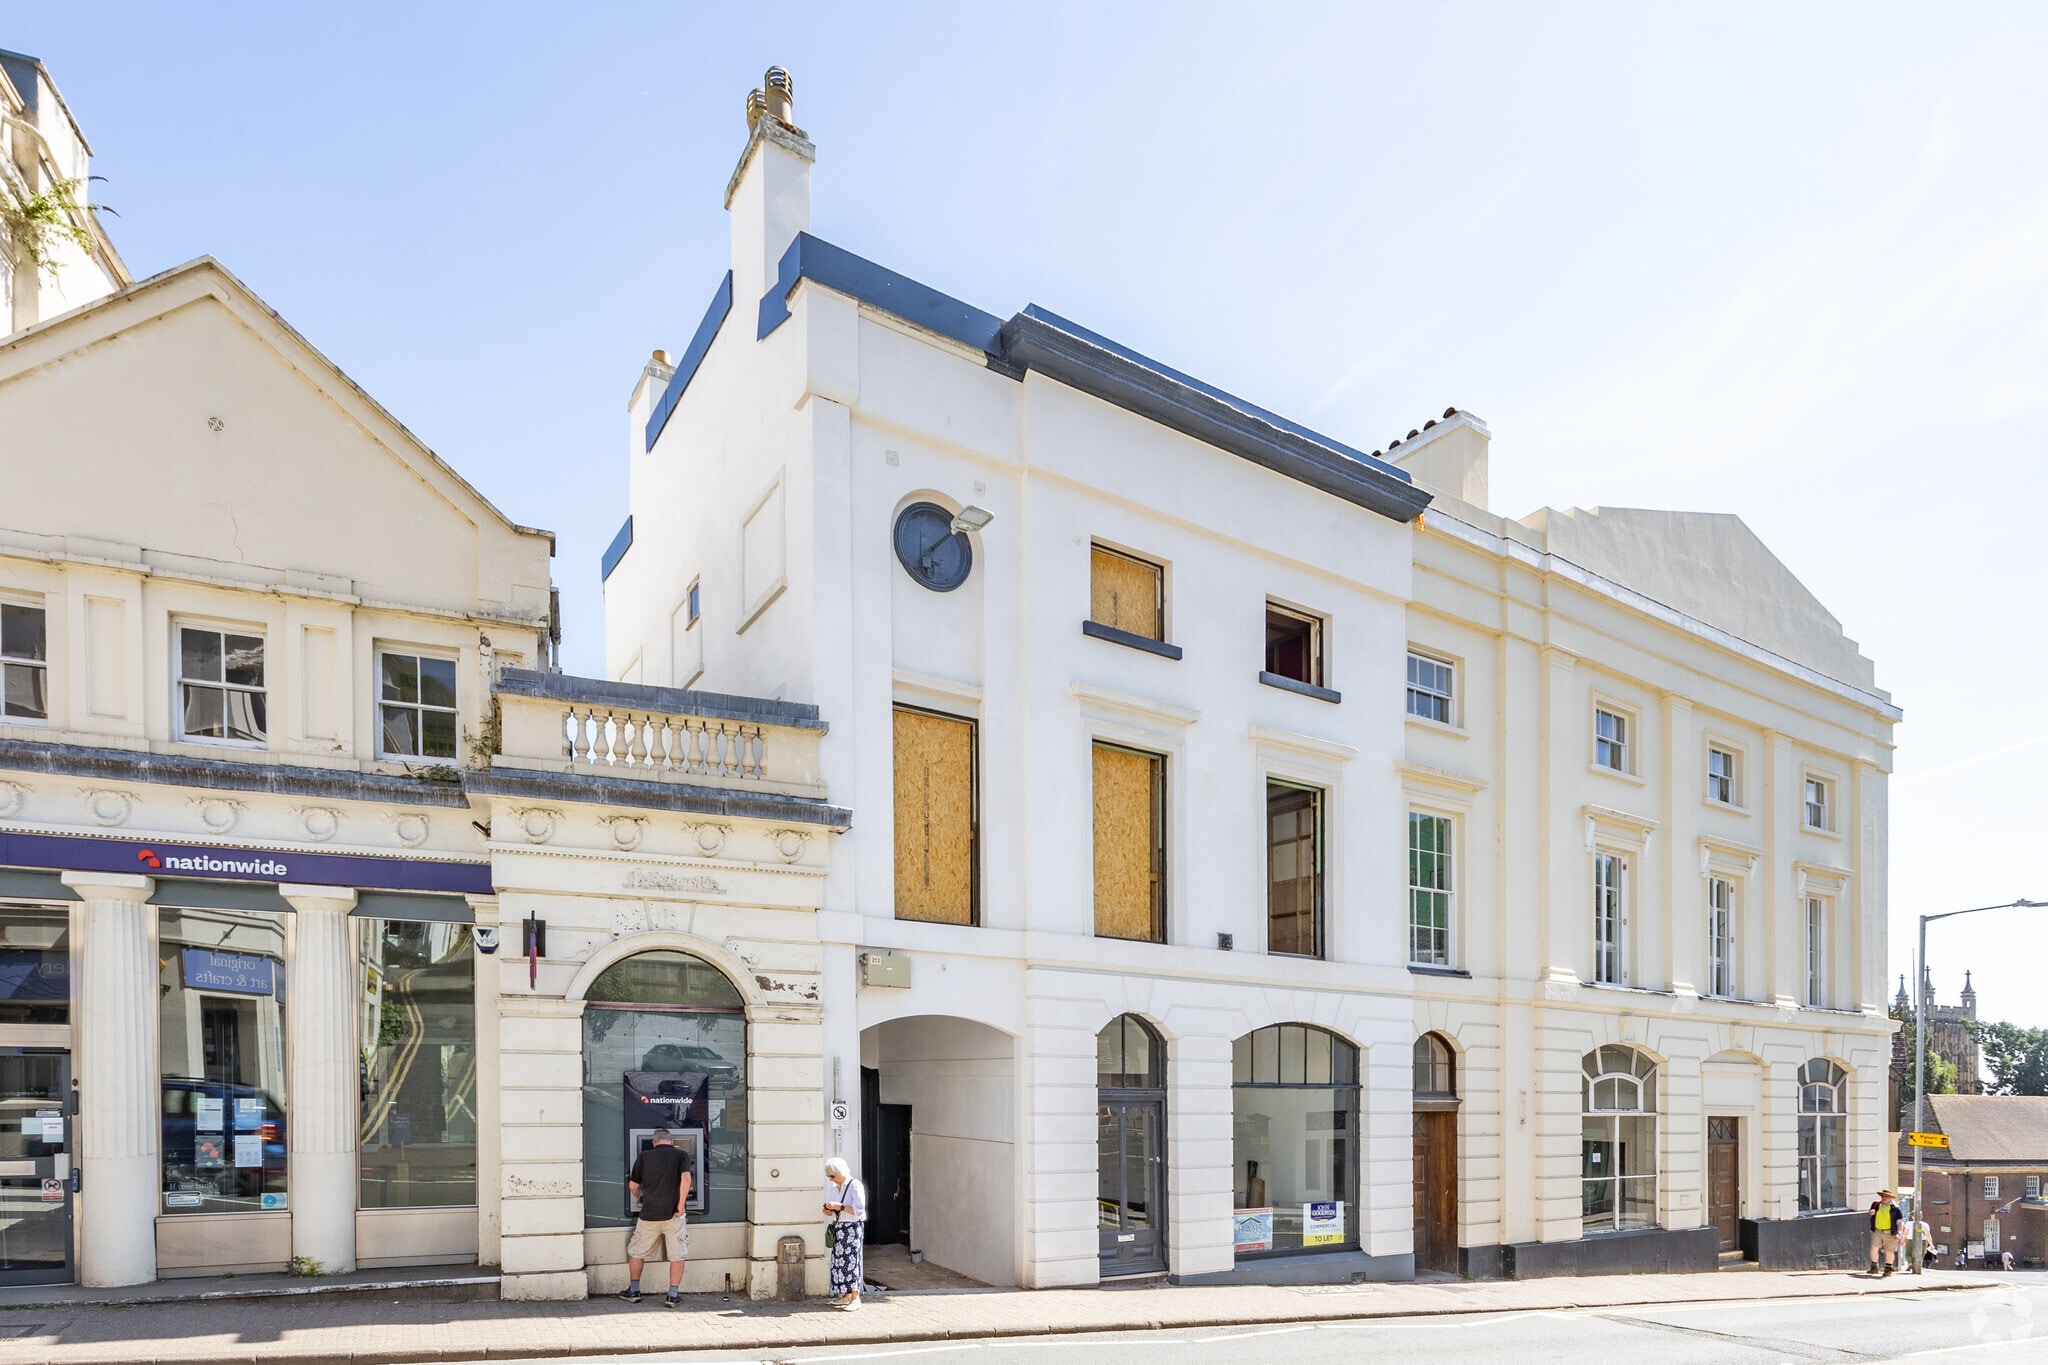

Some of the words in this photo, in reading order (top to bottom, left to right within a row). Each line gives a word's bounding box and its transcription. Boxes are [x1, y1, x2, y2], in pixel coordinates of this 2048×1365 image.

[165, 855, 287, 876] nationwide
[650, 1096, 693, 1104] nationwide
[1121, 1106, 1126, 1114] 8
[1238, 1223, 1264, 1235] HAUS
